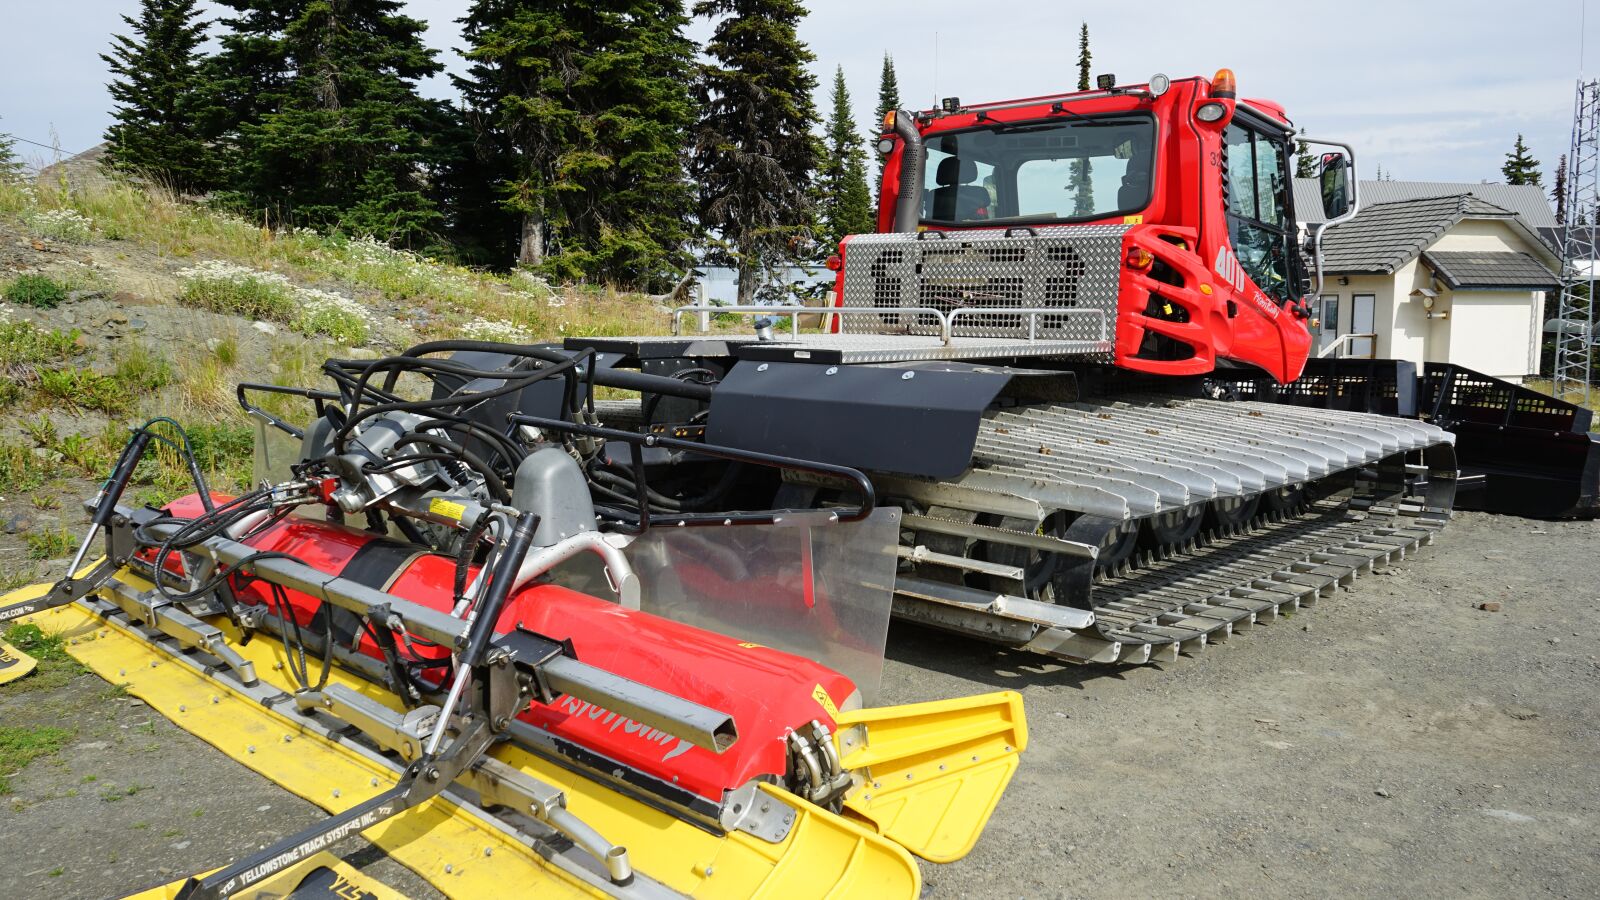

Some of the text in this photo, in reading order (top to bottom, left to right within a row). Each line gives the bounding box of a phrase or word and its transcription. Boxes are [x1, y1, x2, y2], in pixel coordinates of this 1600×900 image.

[1214, 245, 1245, 293] 400
[239, 848, 300, 885] YELLOWSTONE
[299, 836, 326, 855] TRACK
[361, 812, 377, 828] INC.
